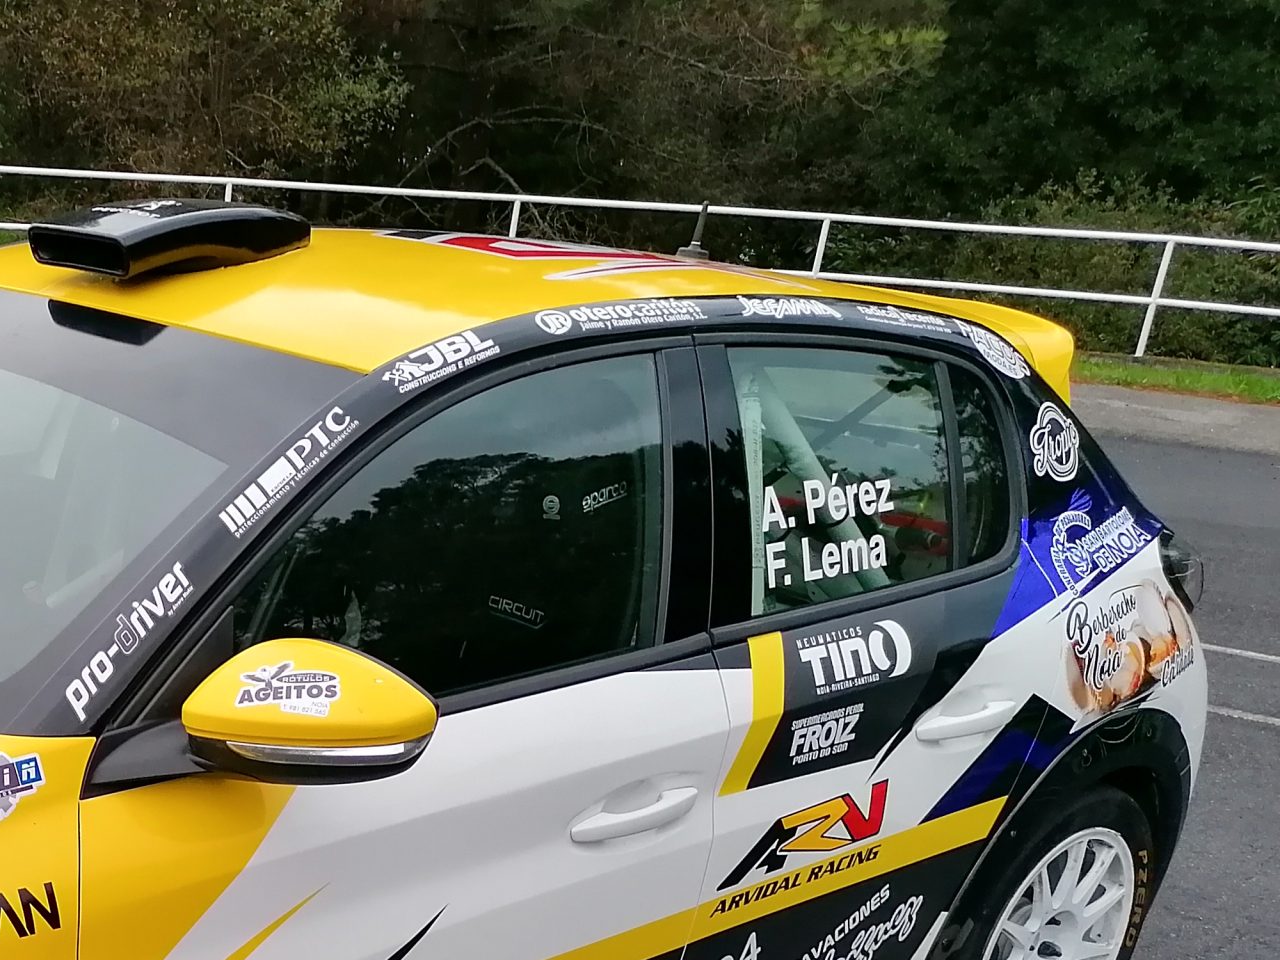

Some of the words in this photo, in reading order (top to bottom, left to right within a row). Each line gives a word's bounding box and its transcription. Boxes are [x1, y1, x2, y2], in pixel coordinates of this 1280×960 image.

[580, 320, 604, 331] Jaime
[612, 316, 640, 327] Ramón
[642, 314, 663, 325] Otero
[399, 365, 457, 394] CONSTRUCCIONS
[464, 345, 501, 367] REFORMAS
[408, 329, 495, 372] JBL
[285, 405, 351, 470] PTC
[234, 484, 290, 539] perfeccionamiento
[294, 456, 320, 481] técnicas
[328, 419, 360, 450] conducción
[763, 486, 796, 532] A.
[803, 473, 895, 524] Pérez
[766, 541, 793, 589] F.
[801, 533, 888, 582] Lema
[1094, 551, 1114, 569] DE
[1106, 524, 1150, 563] NOIA
[489, 594, 546, 624] CIRCUIT
[1066, 592, 1137, 655] Berberecho
[65, 561, 192, 723] pro-driver
[1115, 624, 1126, 643] de
[1082, 643, 1122, 691] Noia
[238, 684, 338, 704] AGEITOS
[789, 713, 860, 757] FROIZ
[792, 750, 820, 766] PORTO
[819, 746, 832, 758] DO
[831, 742, 849, 755] SON
[709, 873, 802, 918] ARVIDAL
[806, 845, 882, 884] RACING
